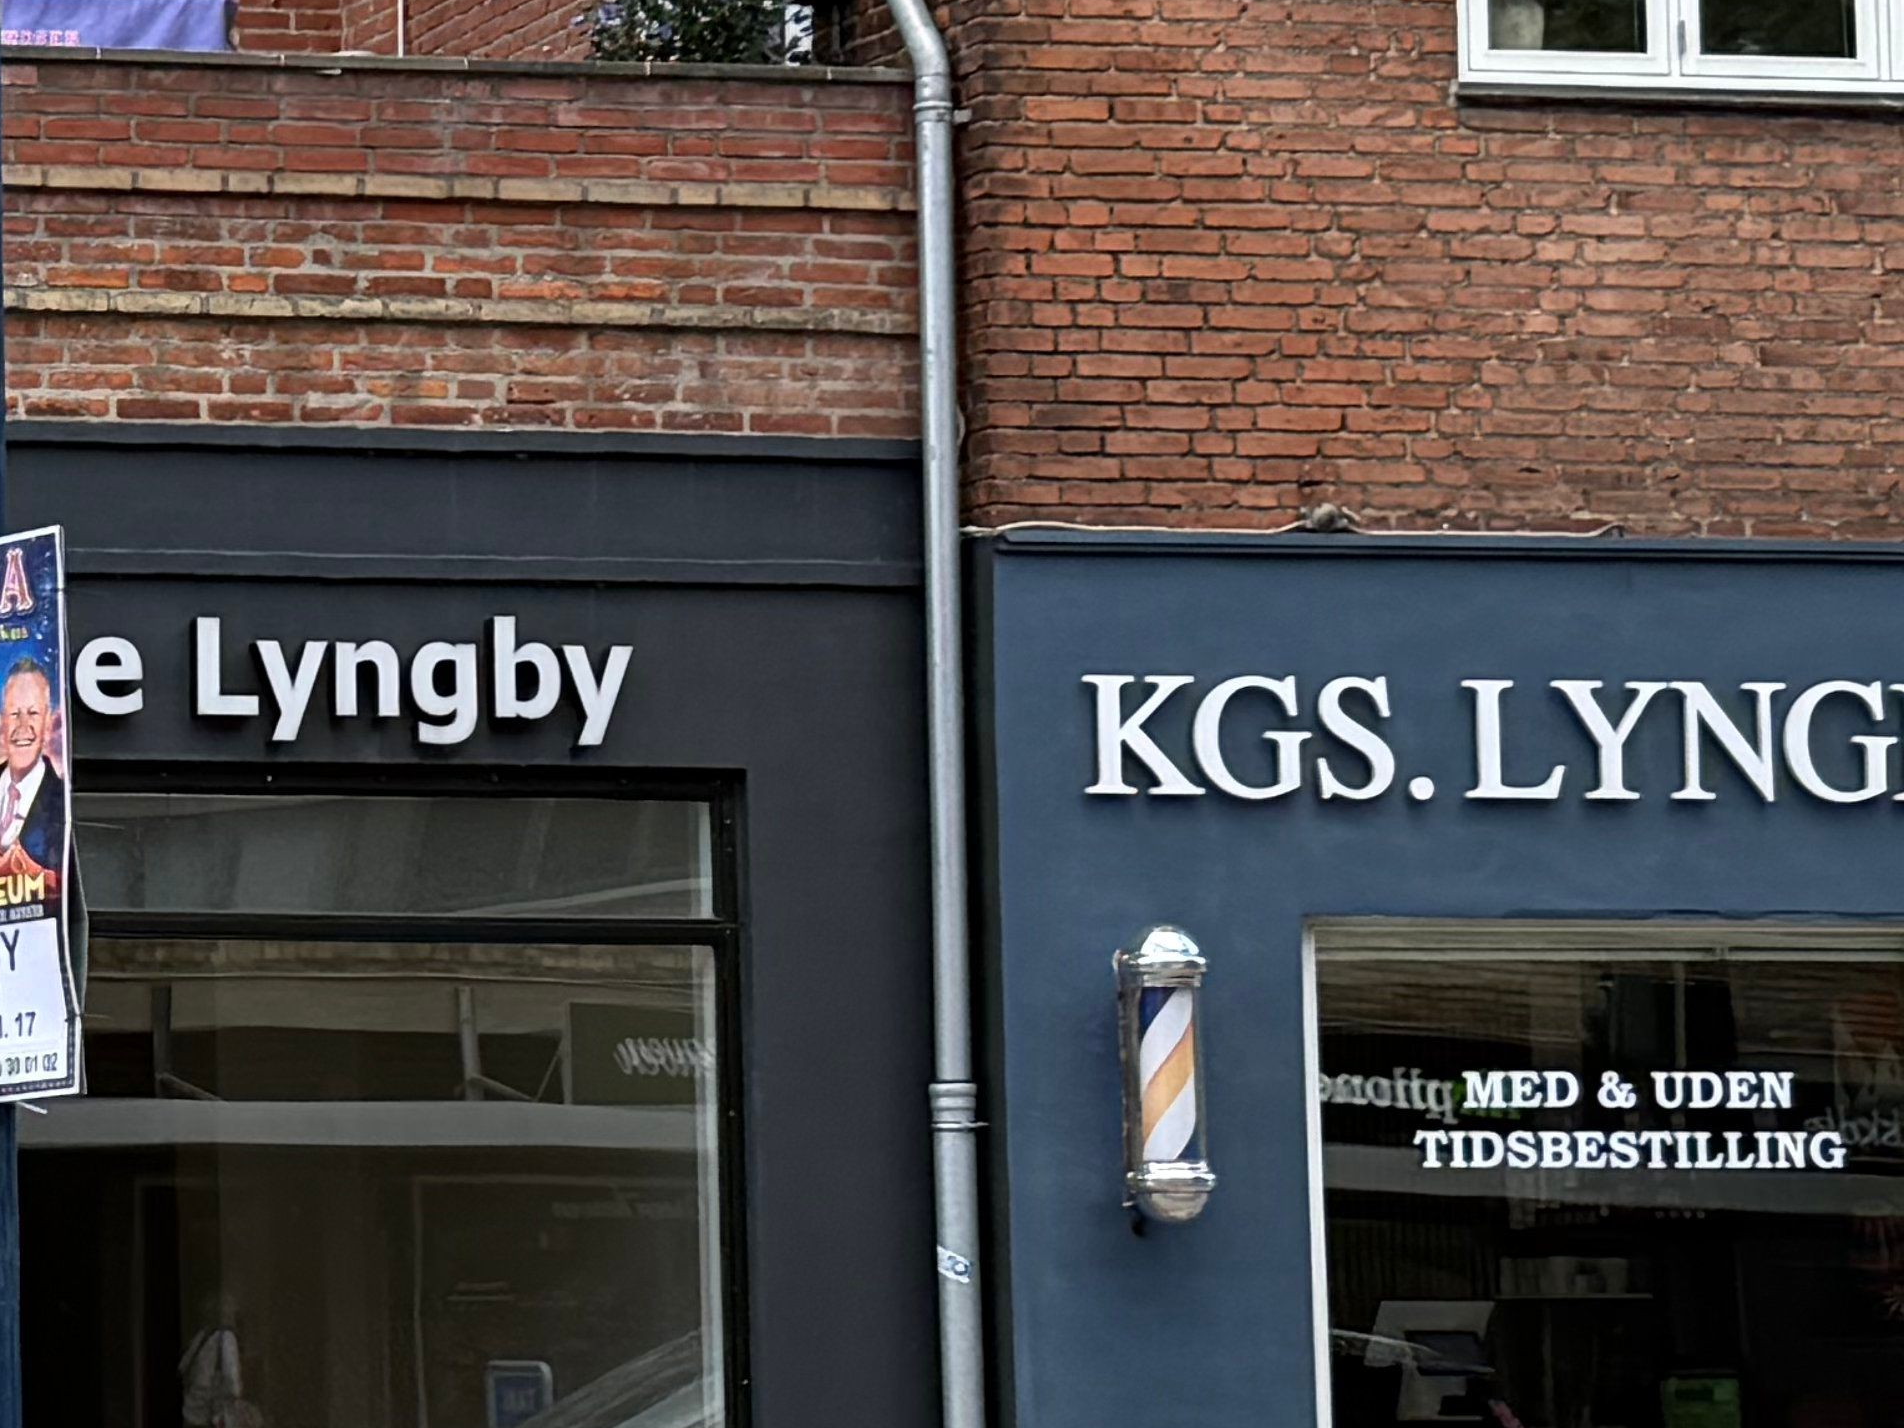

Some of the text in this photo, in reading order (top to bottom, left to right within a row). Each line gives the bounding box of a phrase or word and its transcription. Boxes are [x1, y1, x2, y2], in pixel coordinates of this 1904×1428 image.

[194, 616, 633, 745] Lyngby
[1081, 673, 1904, 803] KGS. LYNG
[15, 1012, 36, 1037] 17
[25, 1054, 38, 1073] 01
[1462, 1069, 1794, 1109] MED & UDEN
[1414, 1129, 1848, 1170] TIDSBESTILLING
